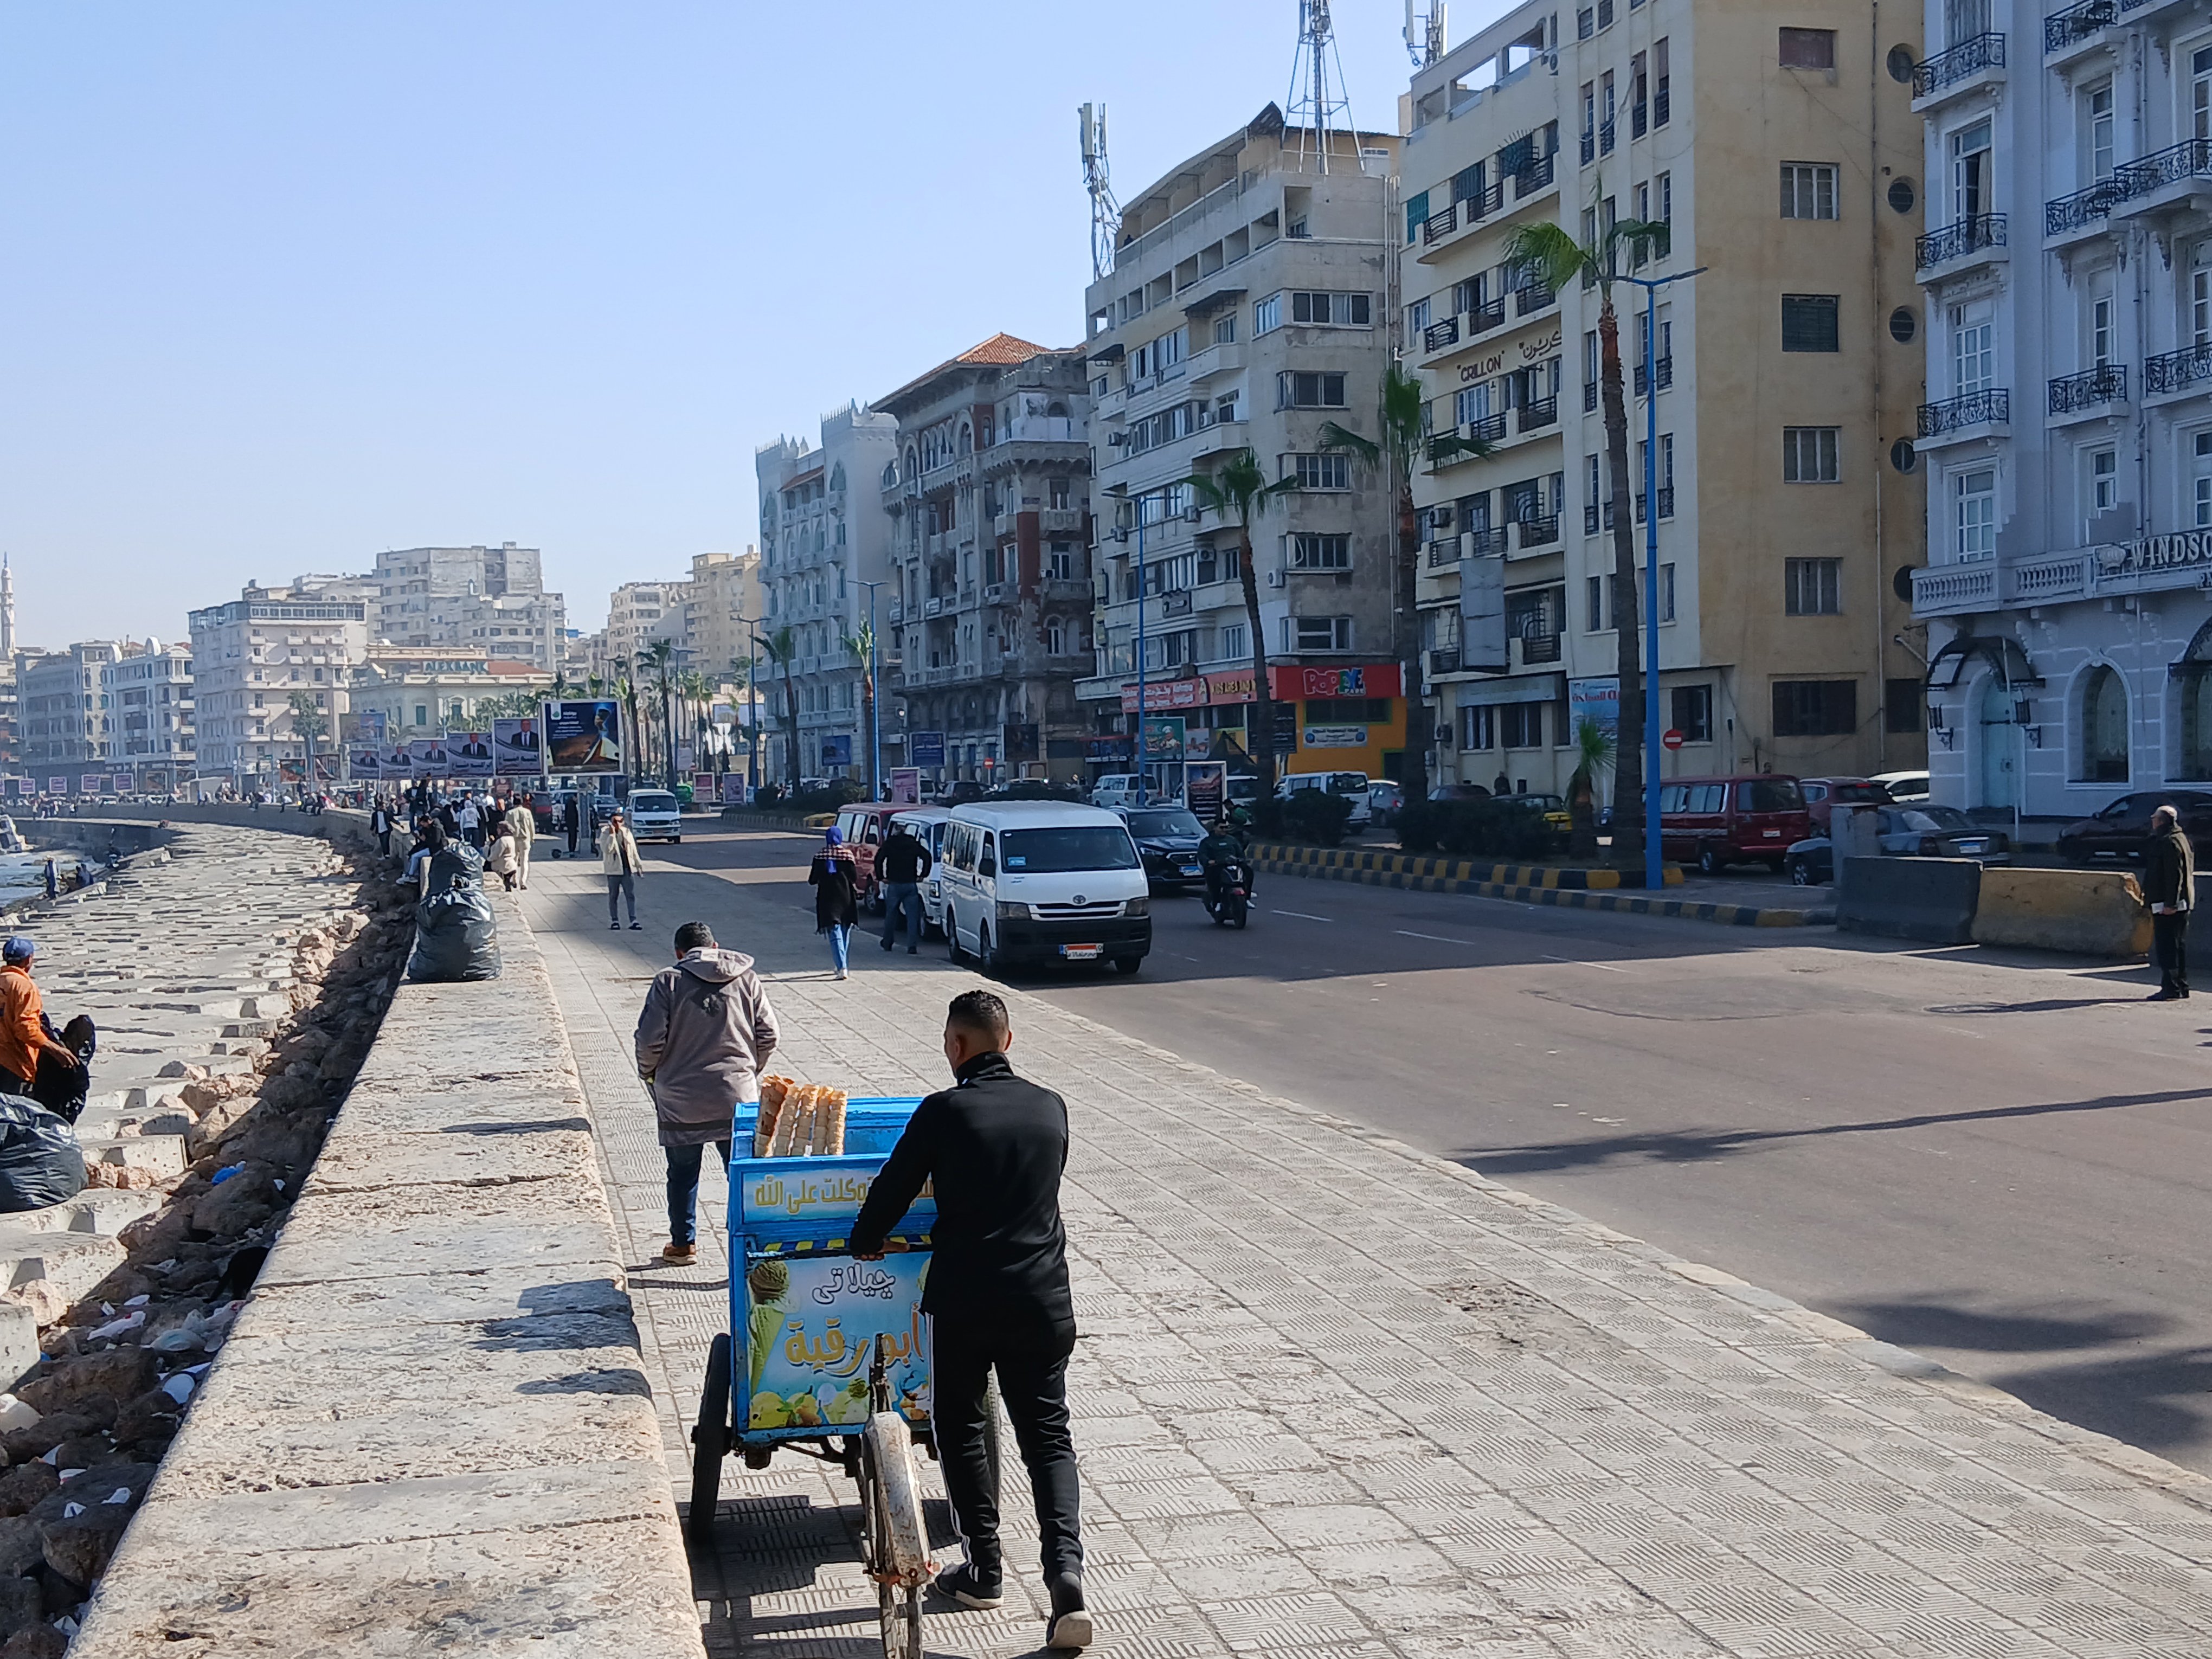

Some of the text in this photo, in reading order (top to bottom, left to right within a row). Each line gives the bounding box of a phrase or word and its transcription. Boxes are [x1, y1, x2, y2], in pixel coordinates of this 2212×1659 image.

[755, 1174, 783, 1206] الله
[787, 1179, 816, 1214] على
[820, 1176, 873, 1207] وكلت
[785, 1317, 870, 1376] رقية
